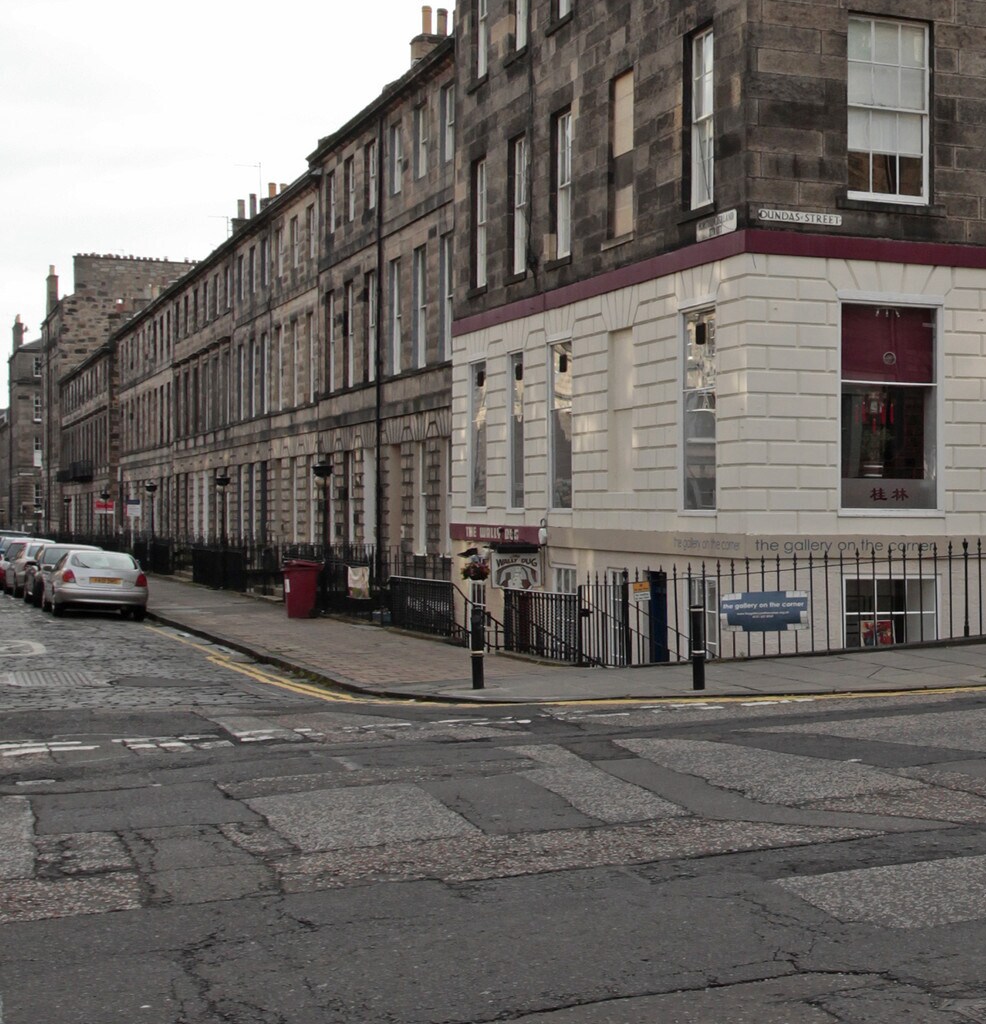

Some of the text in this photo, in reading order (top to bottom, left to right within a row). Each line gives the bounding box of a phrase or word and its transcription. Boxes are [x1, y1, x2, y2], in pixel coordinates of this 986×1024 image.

[760, 210, 840, 224] DUNDAS STREET
[755, 538, 935, 553] the gallery on the corner
[734, 602, 758, 610] gallery
